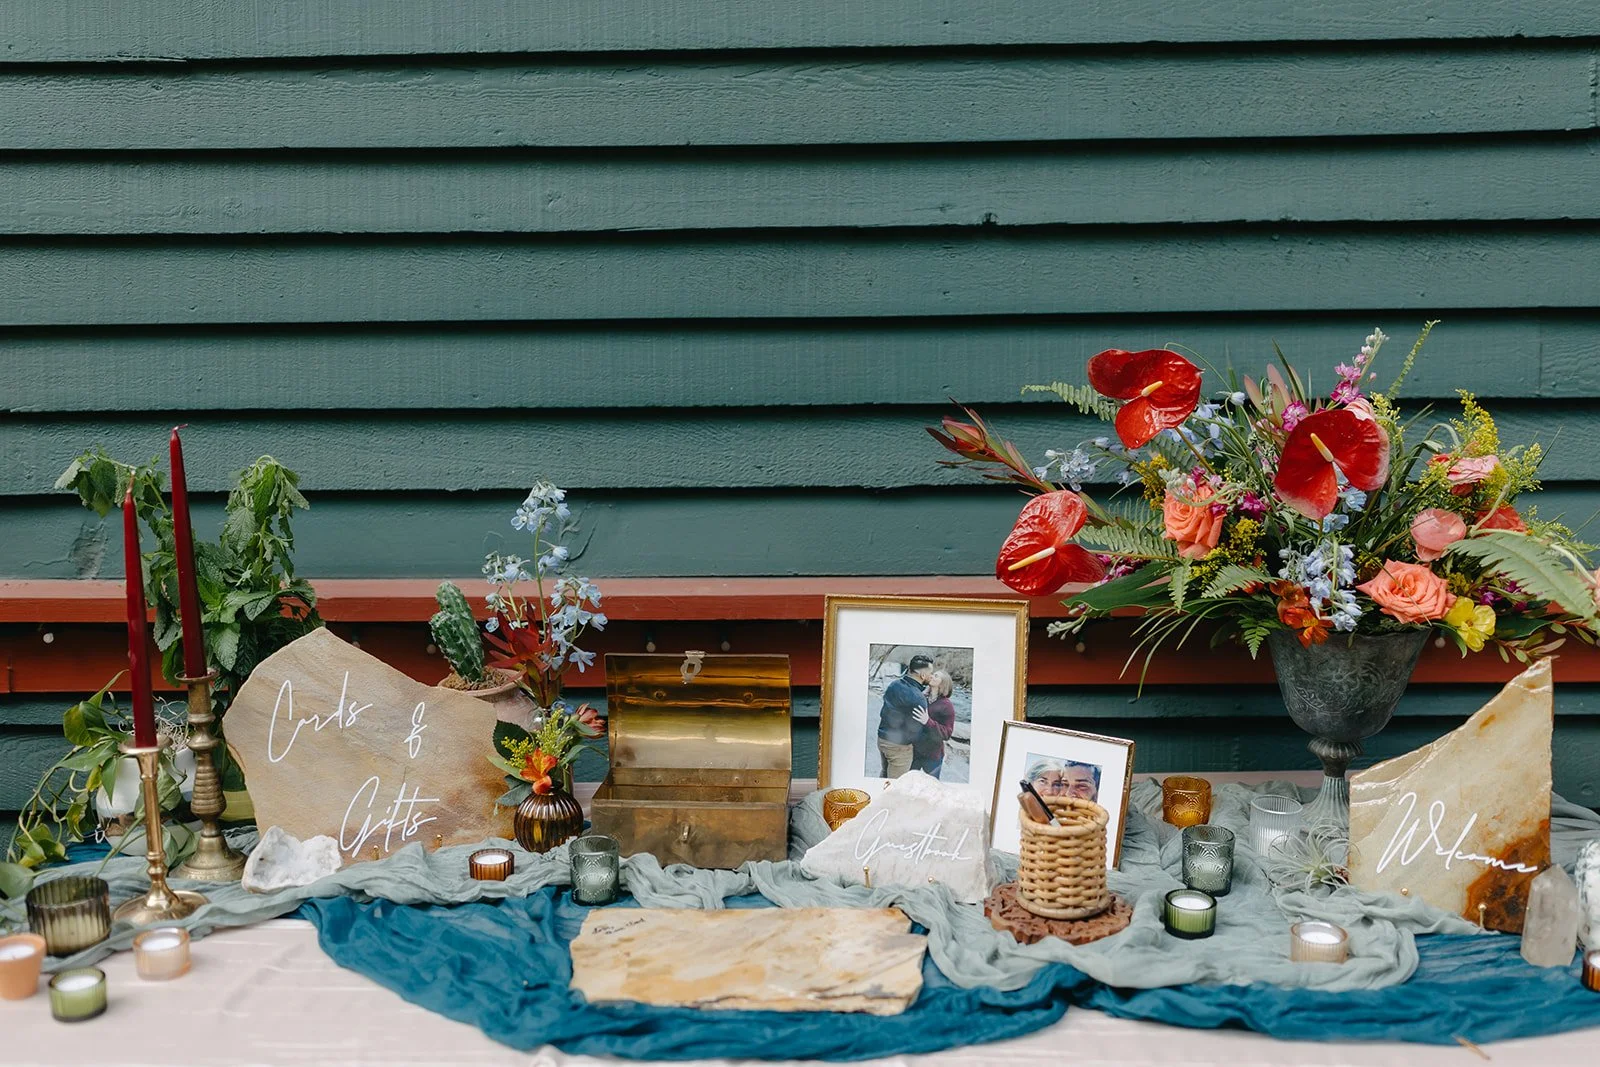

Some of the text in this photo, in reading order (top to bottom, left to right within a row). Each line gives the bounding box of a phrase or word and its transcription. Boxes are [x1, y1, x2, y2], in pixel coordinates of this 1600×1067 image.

[268, 671, 428, 763] Cards &
[340, 776, 440, 858] Gifts
[854, 808, 973, 866] Guestbook
[1376, 793, 1538, 874] Welcome
